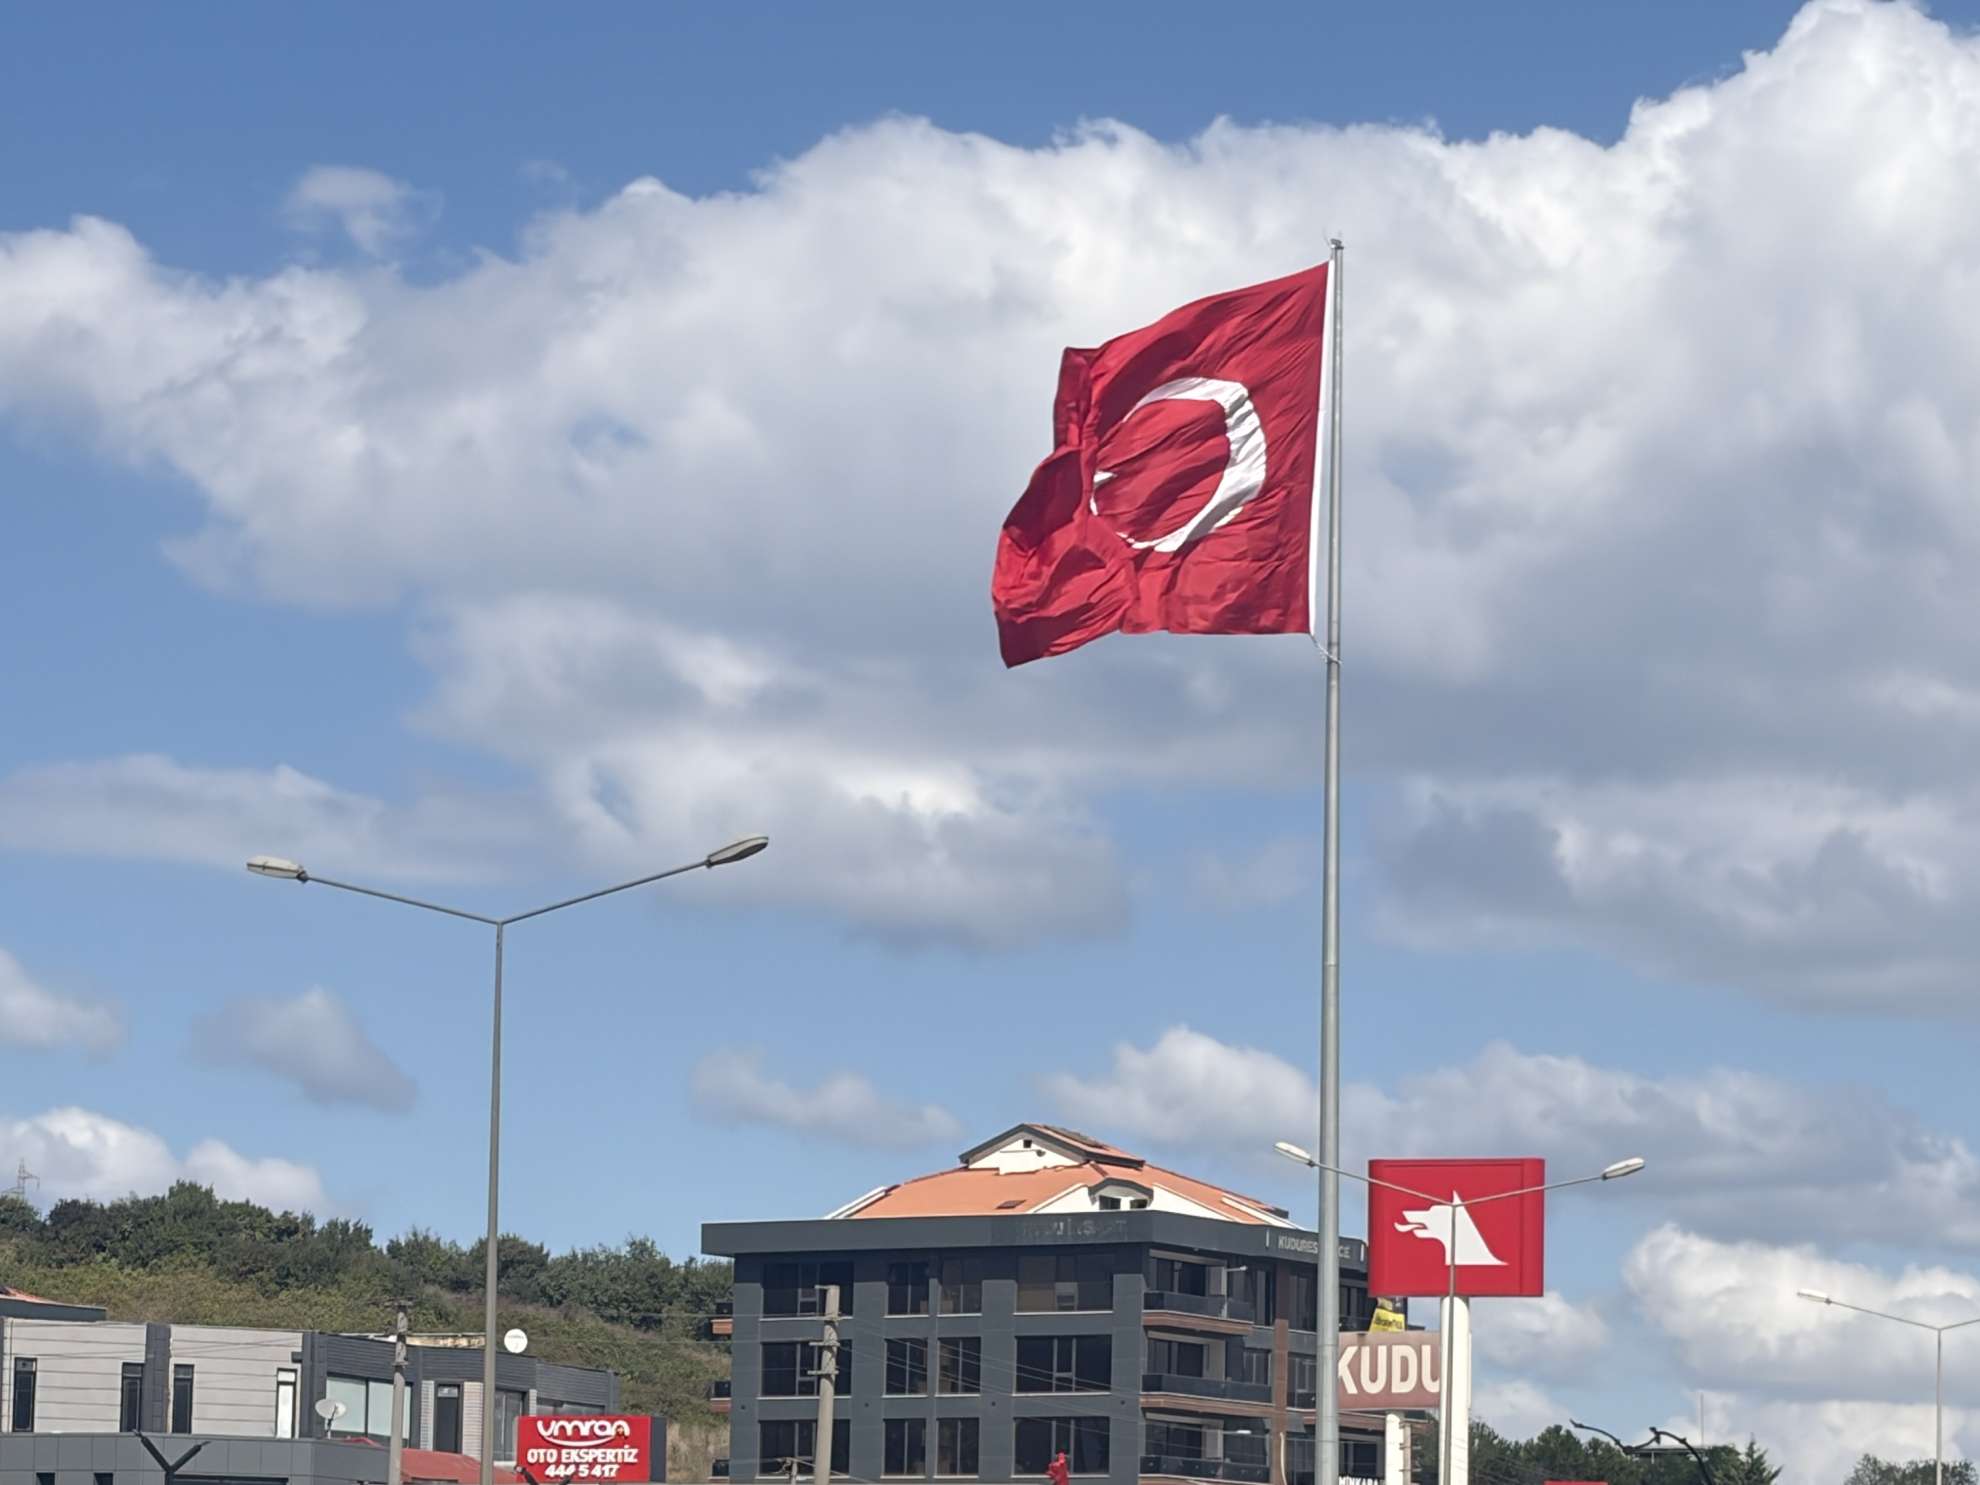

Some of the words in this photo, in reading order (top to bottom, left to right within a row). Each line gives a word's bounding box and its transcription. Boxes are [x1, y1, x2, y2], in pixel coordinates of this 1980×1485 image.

[1338, 1344, 1440, 1394] KUDU
[526, 1448, 558, 1463] OTO
[561, 1444, 639, 1463] EKSPERTİZ
[578, 1464, 590, 1477] 5
